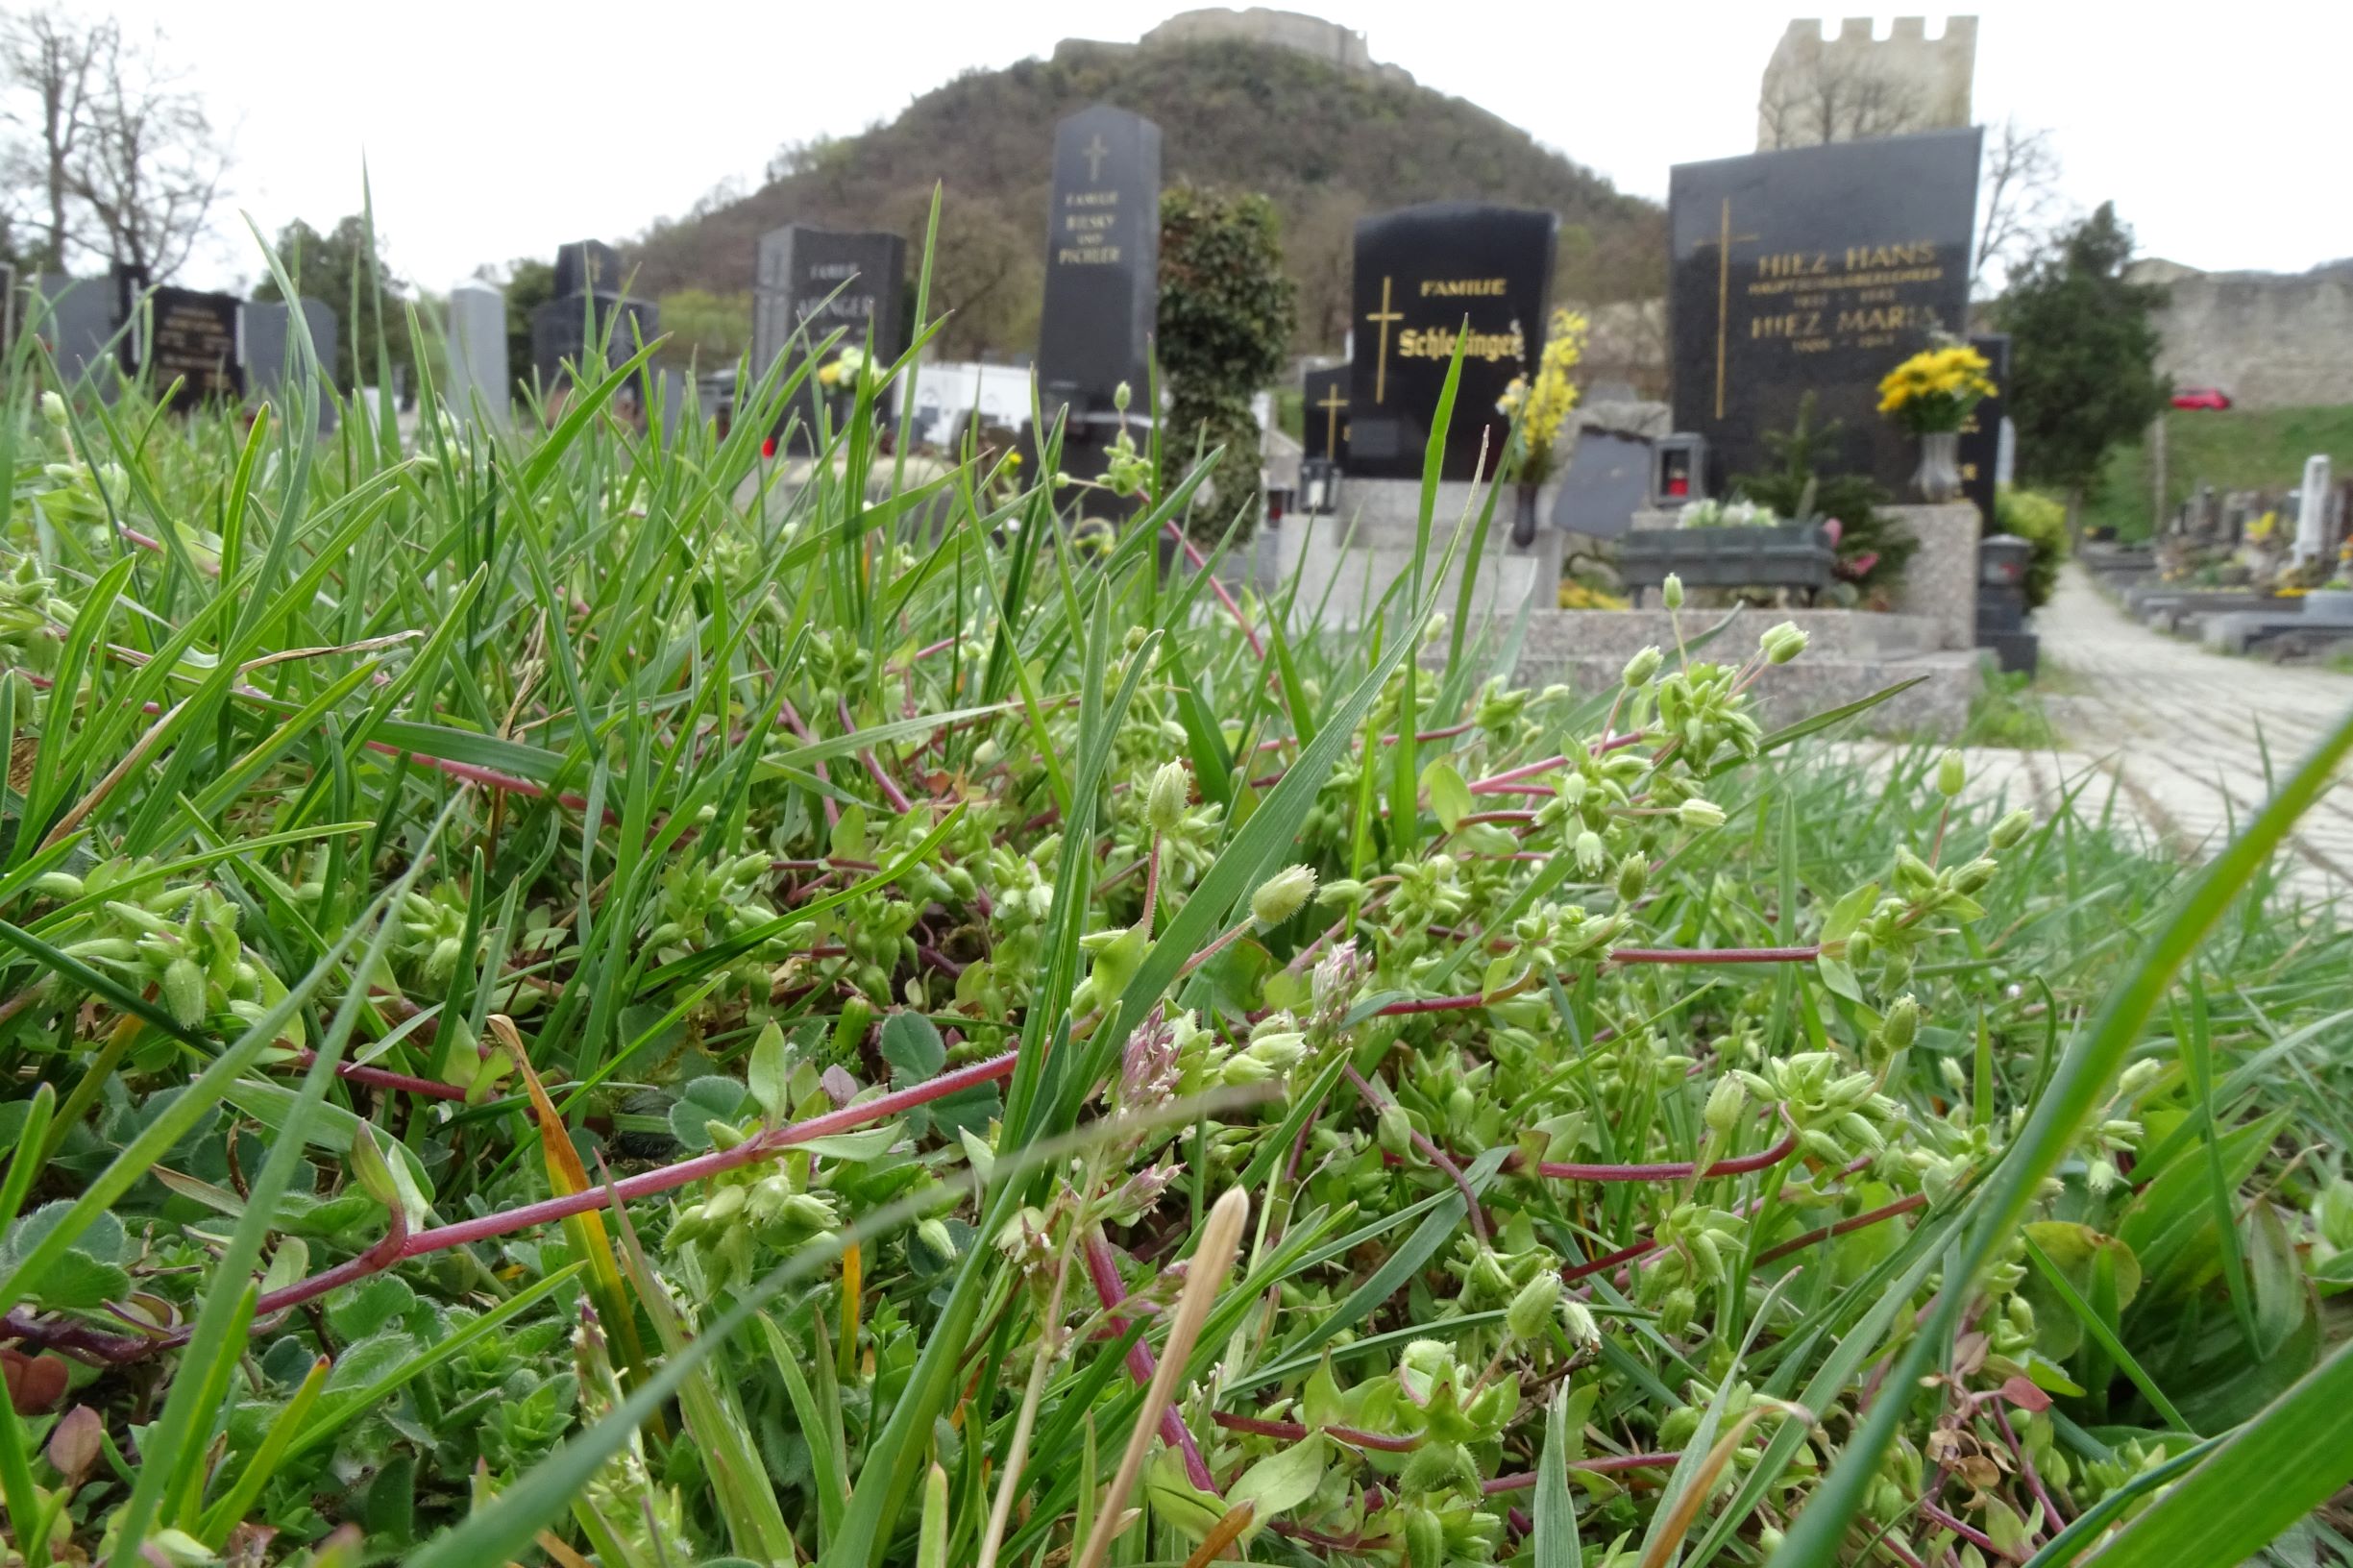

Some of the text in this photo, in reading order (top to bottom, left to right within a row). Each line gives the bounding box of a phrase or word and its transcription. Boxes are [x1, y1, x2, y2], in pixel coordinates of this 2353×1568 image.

[1846, 242, 1936, 271] HANS
[1420, 279, 1507, 297] FAMILIE
[1751, 313, 1822, 339] HIEZ
[1399, 328, 1522, 361] Schleinger
